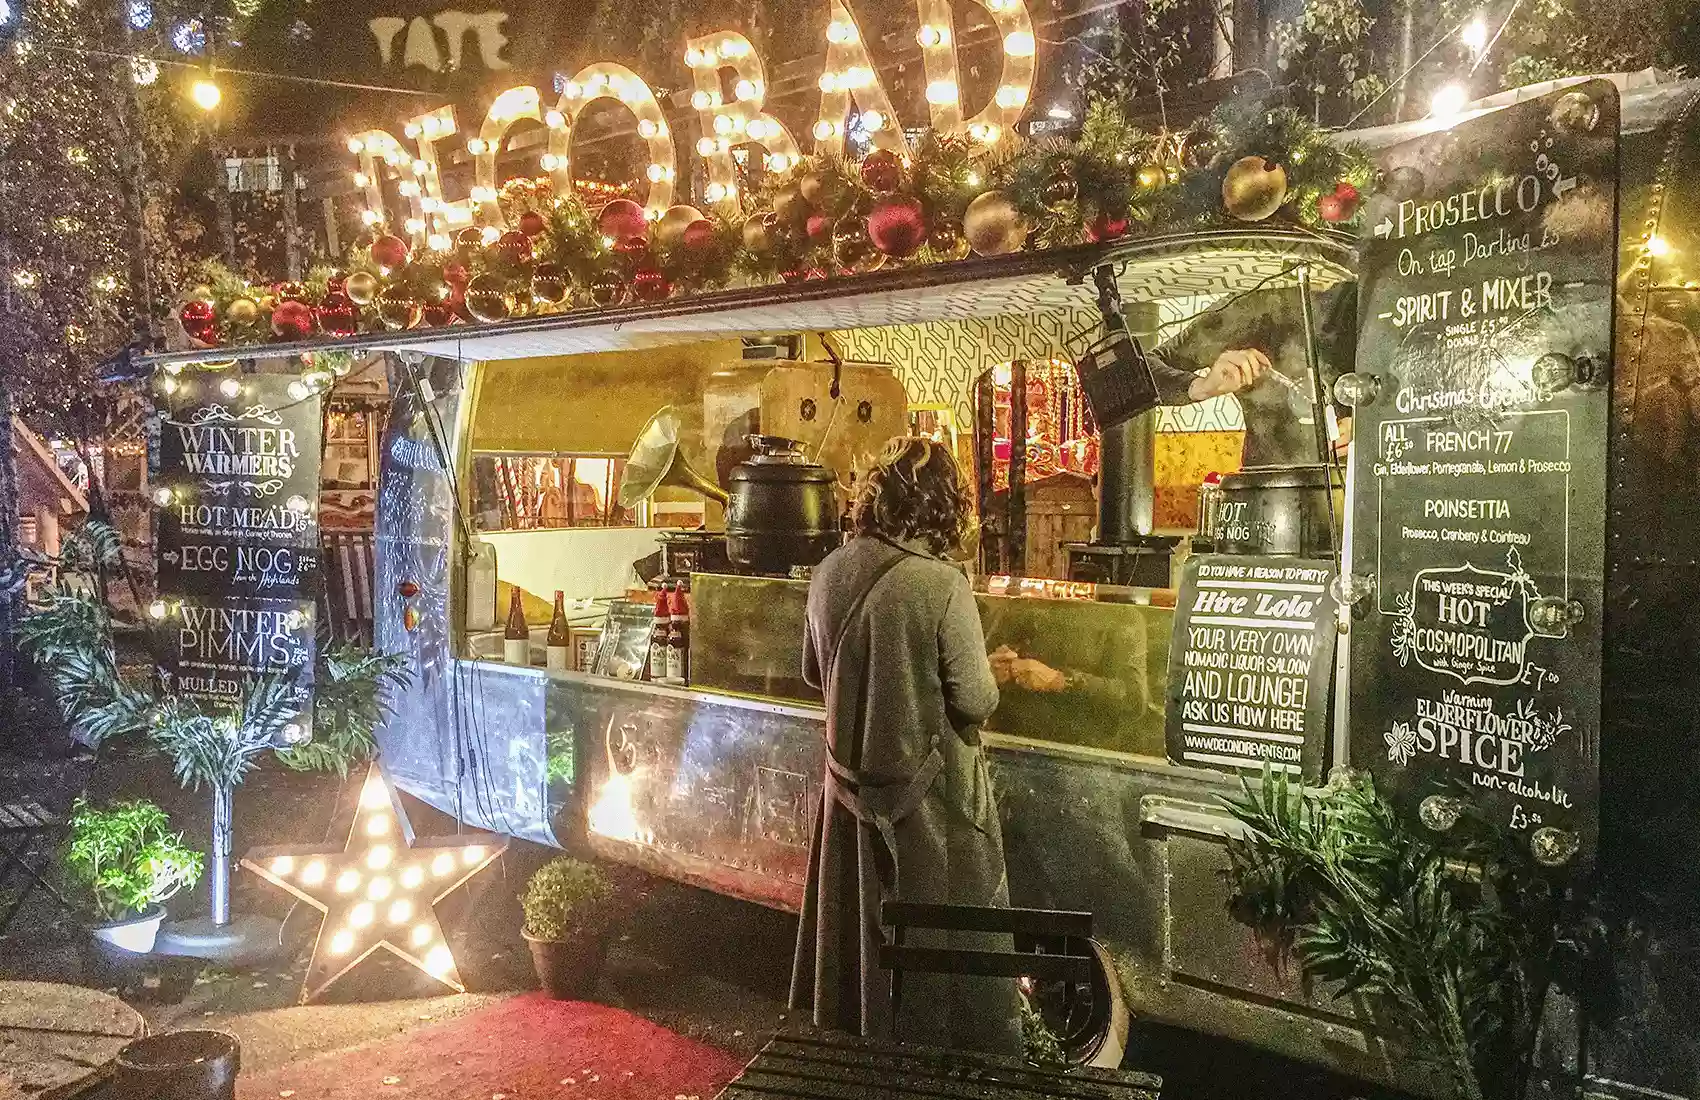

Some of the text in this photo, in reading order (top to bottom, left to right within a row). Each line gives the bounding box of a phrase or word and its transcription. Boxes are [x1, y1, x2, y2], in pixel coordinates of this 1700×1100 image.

[1398, 175, 1541, 238] PROSECCO
[1398, 249, 1424, 276] On
[1430, 250, 1456, 278] tap
[1463, 229, 1532, 271] Darling
[1393, 271, 1552, 326] SPIRIT & MIXER
[1445, 321, 1477, 336] SINGLE
[1446, 335, 1479, 348] DOUBLE
[1396, 385, 1474, 413] Christmas
[177, 426, 300, 458] WINTER
[1385, 424, 1408, 442] ALL
[1426, 431, 1513, 454] FRENCH 77
[1488, 460, 1518, 474] Lemon
[1528, 460, 1571, 473] Prosecco
[180, 504, 226, 526] HOT
[232, 507, 295, 529] MEAD
[1219, 502, 1247, 522] HOT
[1425, 499, 1511, 519] POINSETTIA
[1226, 526, 1250, 540] NOG
[1441, 528, 1480, 544] Cranberry
[1489, 529, 1531, 545] Cointreau
[180, 545, 291, 573] EGG NOG
[256, 571, 300, 591] Highlands
[1210, 565, 1227, 577] YOU
[1246, 567, 1253, 578] A
[1254, 566, 1284, 580] REASON
[1284, 567, 1295, 580] TO
[1422, 579, 1512, 600] THIS WEEK'S SPECIAL
[1192, 591, 1322, 619] Hire 'Lola'
[1438, 594, 1490, 628] HOT
[180, 606, 291, 636] WINTER
[1187, 627, 1313, 656] YOUR VERY OWN
[1416, 628, 1523, 665] COSMOPOLITAN
[1184, 651, 1311, 676] NOMADIC LIQUOR SALOON
[1433, 657, 1496, 676] with Ginger Spice
[179, 677, 238, 694] MULLED
[1182, 671, 1308, 709] AND LOUNGE!
[1443, 689, 1493, 713] Warming
[1182, 701, 1304, 731] ASK US HOW HERE
[1416, 698, 1535, 744] ELDERFLOWER
[1415, 716, 1525, 778] SPICE
[1472, 770, 1573, 809] non-alcoholic
